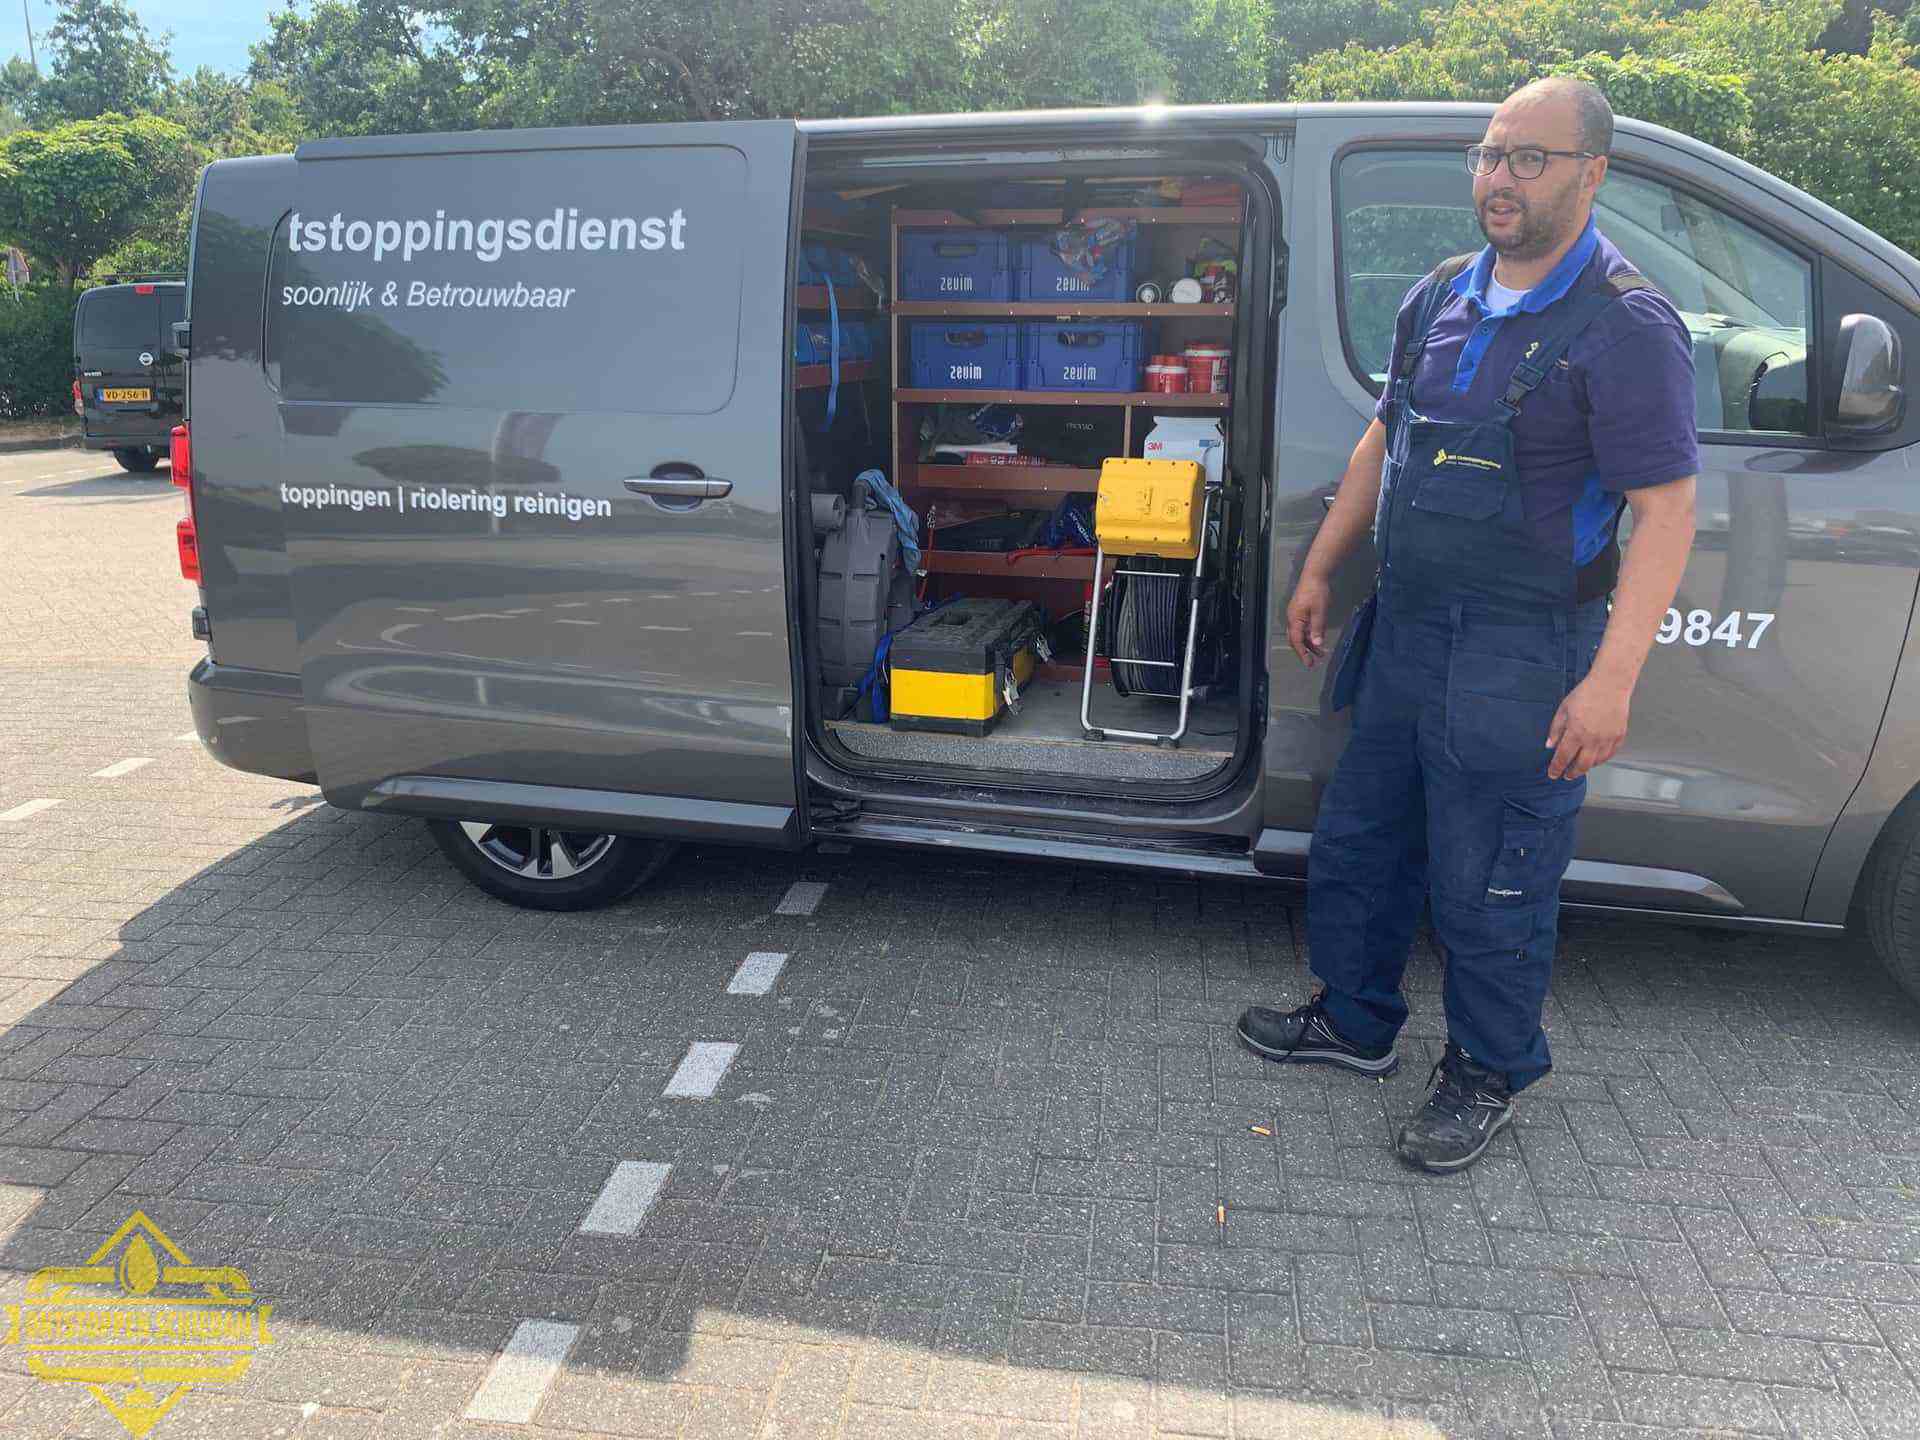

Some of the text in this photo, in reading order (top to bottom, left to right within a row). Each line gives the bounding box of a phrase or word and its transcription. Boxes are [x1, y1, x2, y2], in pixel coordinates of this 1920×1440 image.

[289, 208, 687, 262] tstoppingsdienst
[282, 281, 576, 312] soonlijk & Betrouwbaar
[280, 482, 391, 511] toppingen
[411, 487, 507, 518] riolering
[514, 492, 612, 521] reinigen
[1655, 607, 1776, 649] 9847
